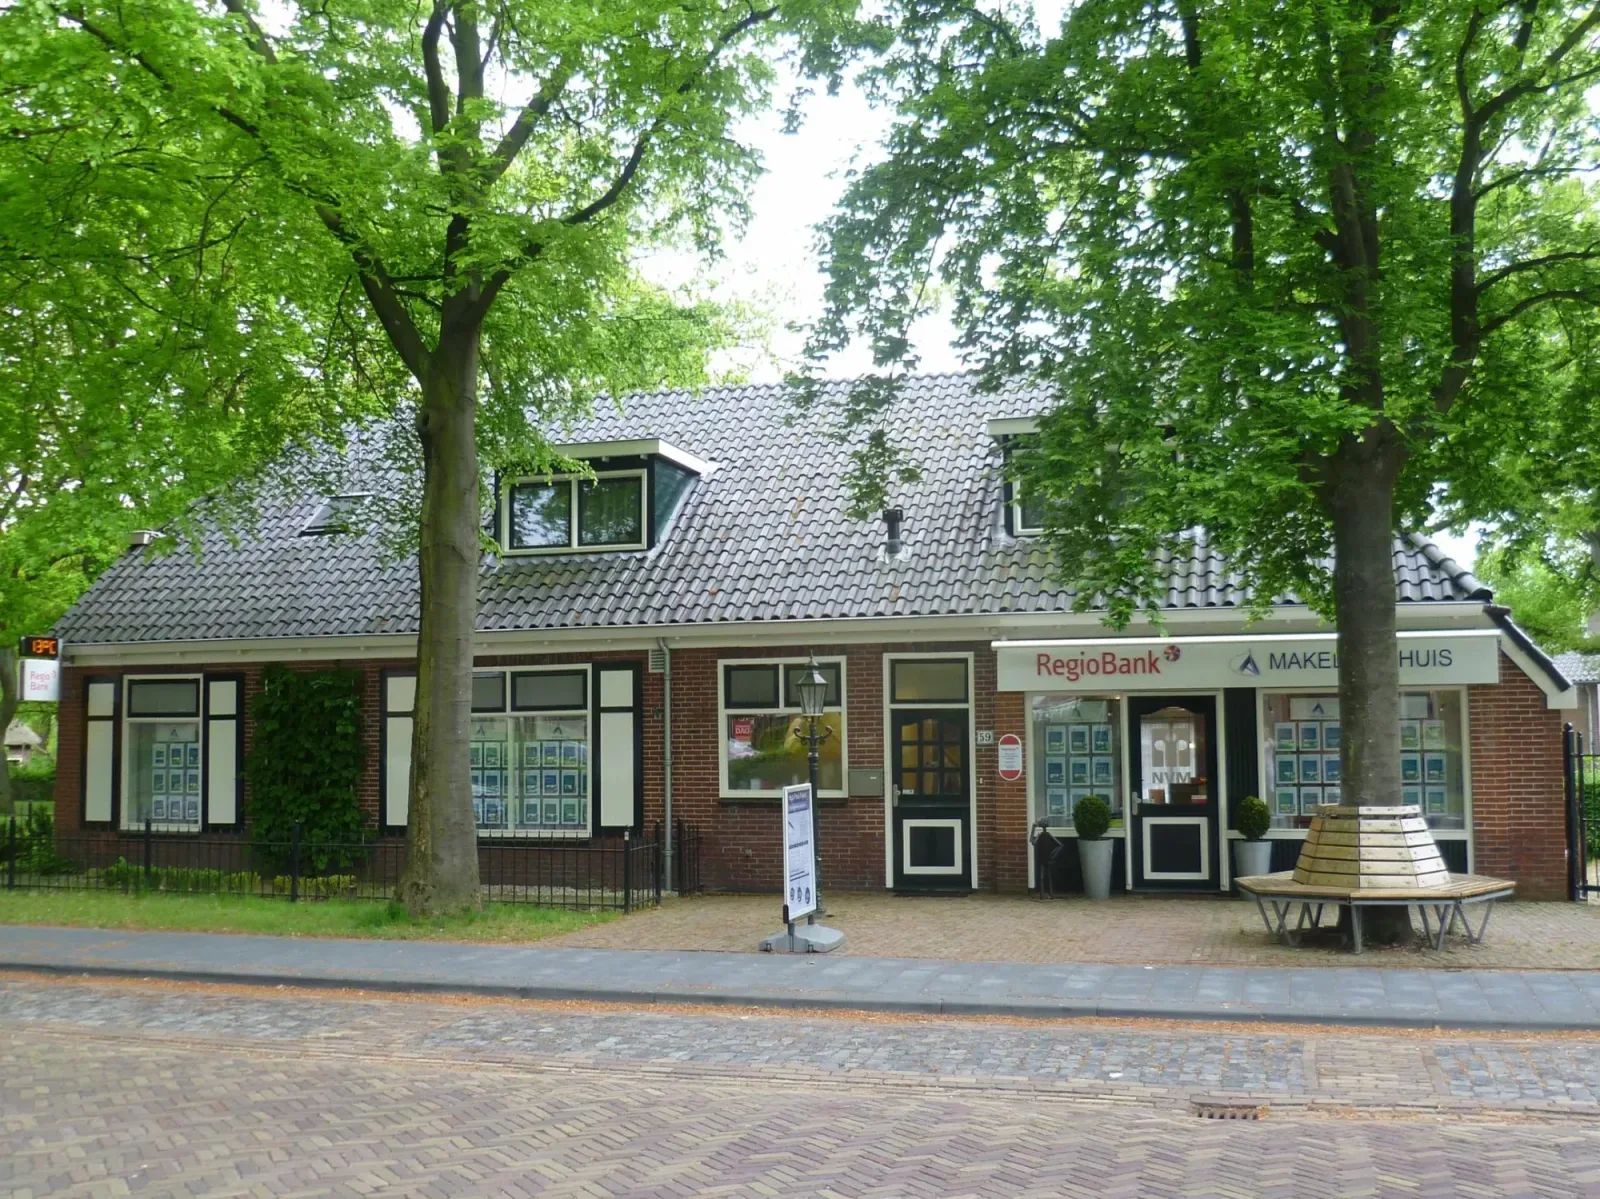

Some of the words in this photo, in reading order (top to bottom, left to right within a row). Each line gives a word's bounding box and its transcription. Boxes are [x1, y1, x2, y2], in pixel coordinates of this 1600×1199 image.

[1269, 649, 1453, 670] MAKELHUIS
[1036, 650, 1161, 682] RegioBank
[30, 670, 51, 682] Regio
[30, 681, 49, 691] Bank
[979, 732, 992, 742] 59
[1151, 771, 1192, 784] NVM
